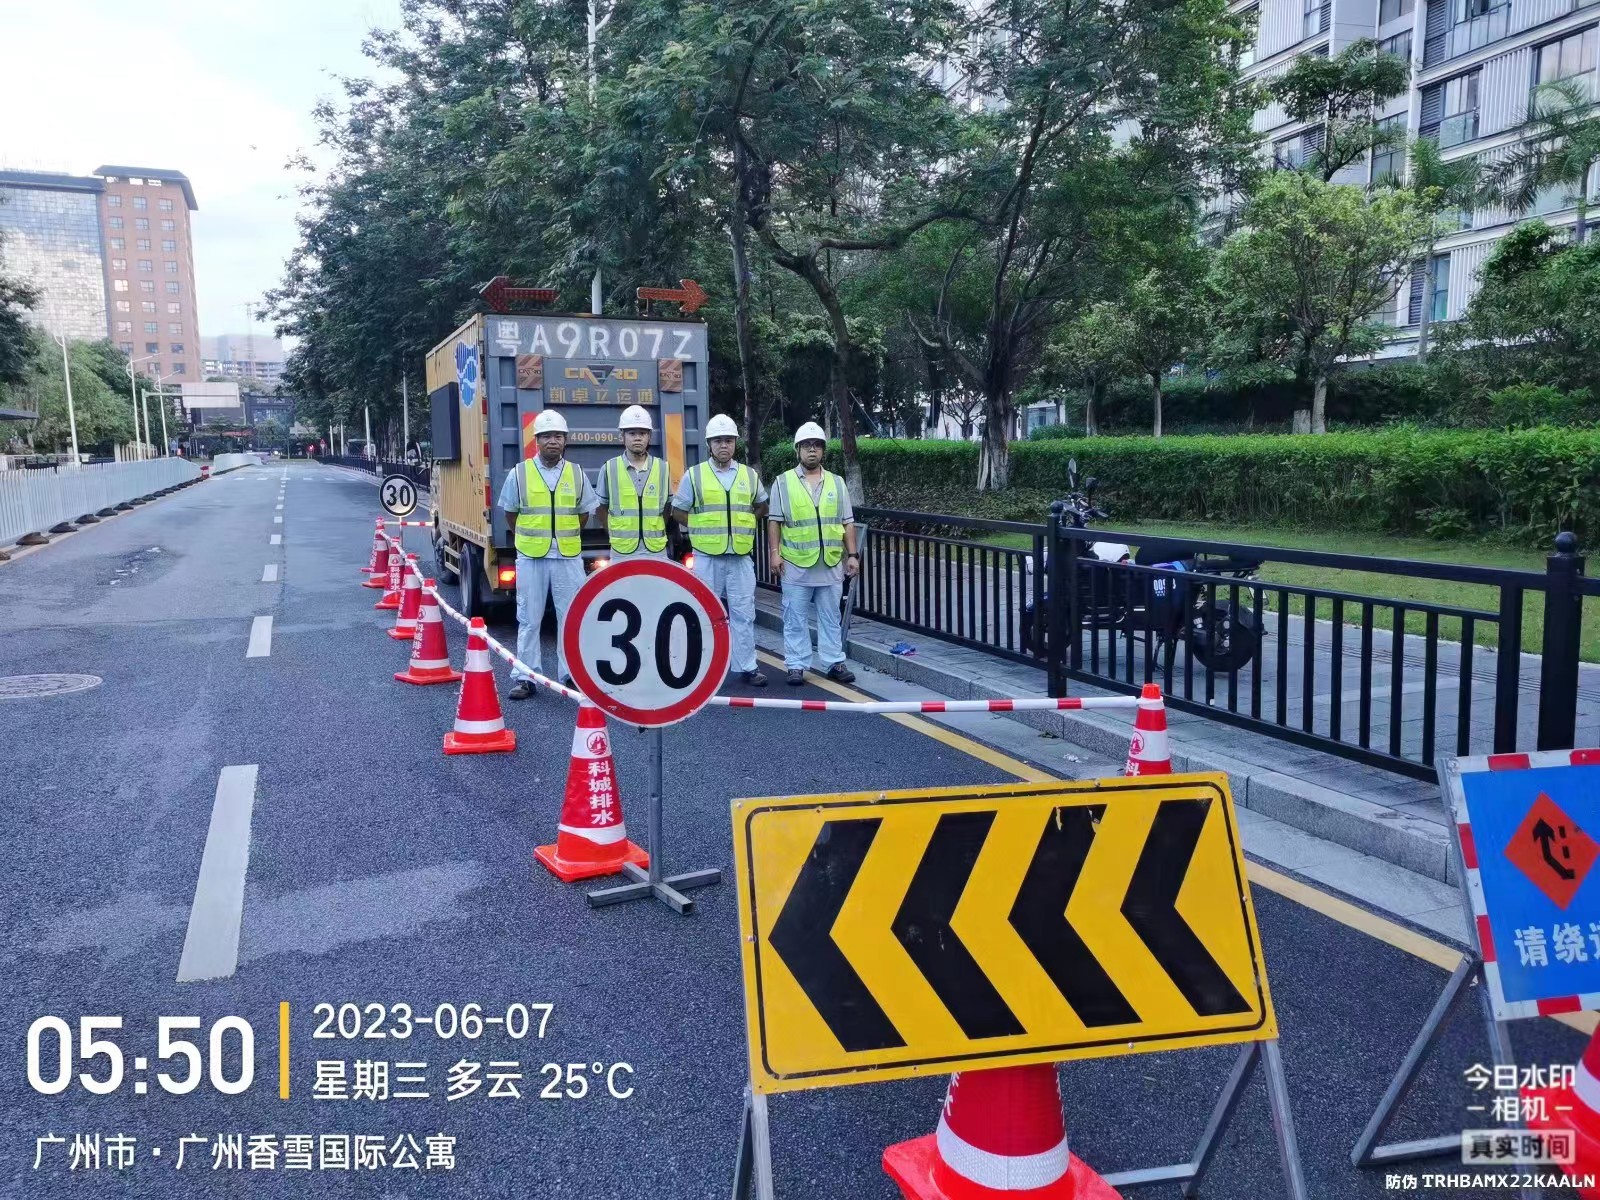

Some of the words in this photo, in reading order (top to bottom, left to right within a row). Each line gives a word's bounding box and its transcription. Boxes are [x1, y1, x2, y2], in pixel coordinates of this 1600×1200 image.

[496, 320, 692, 360] 粤A9R07Z
[386, 484, 411, 507] 30
[596, 598, 703, 689] 30
[588, 761, 614, 825] 科城排水
